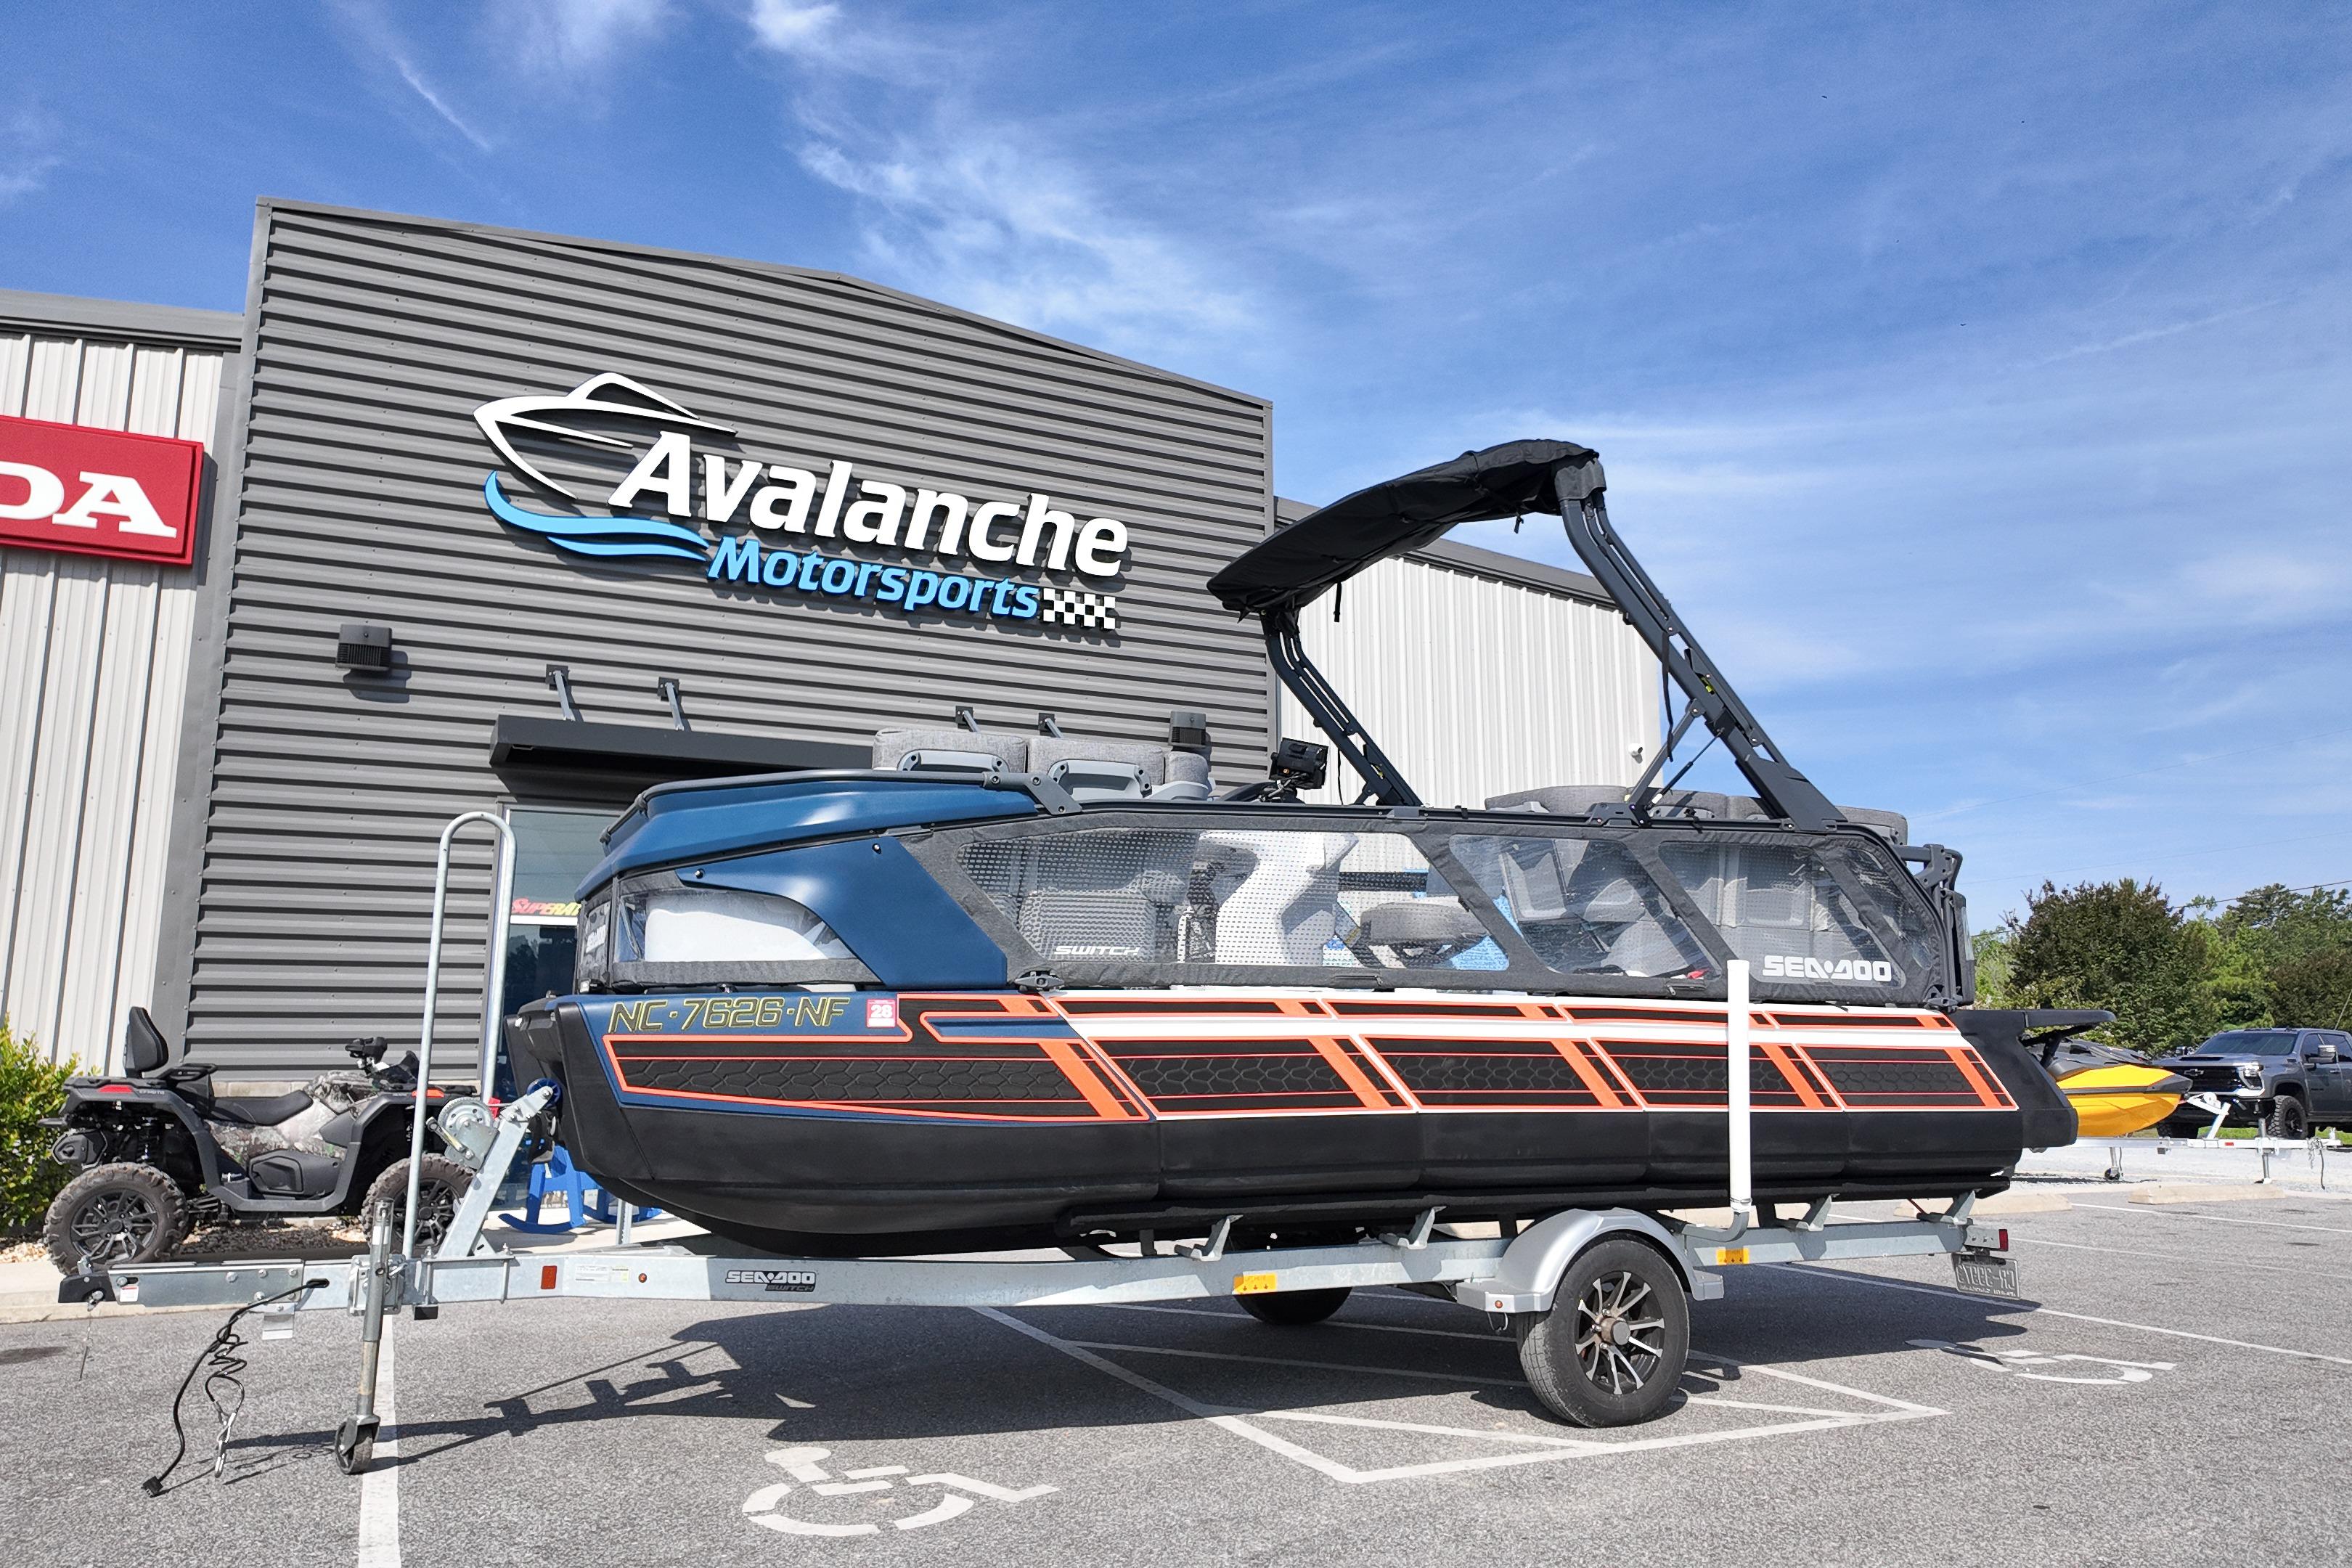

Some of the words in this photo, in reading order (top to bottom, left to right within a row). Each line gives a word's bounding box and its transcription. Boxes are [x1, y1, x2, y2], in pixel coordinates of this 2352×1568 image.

[608, 430, 1129, 578] Avalanche
[707, 536, 1039, 618] Motorsports
[1053, 945, 1140, 956] SWITCH
[870, 1004, 893, 1018] 28
